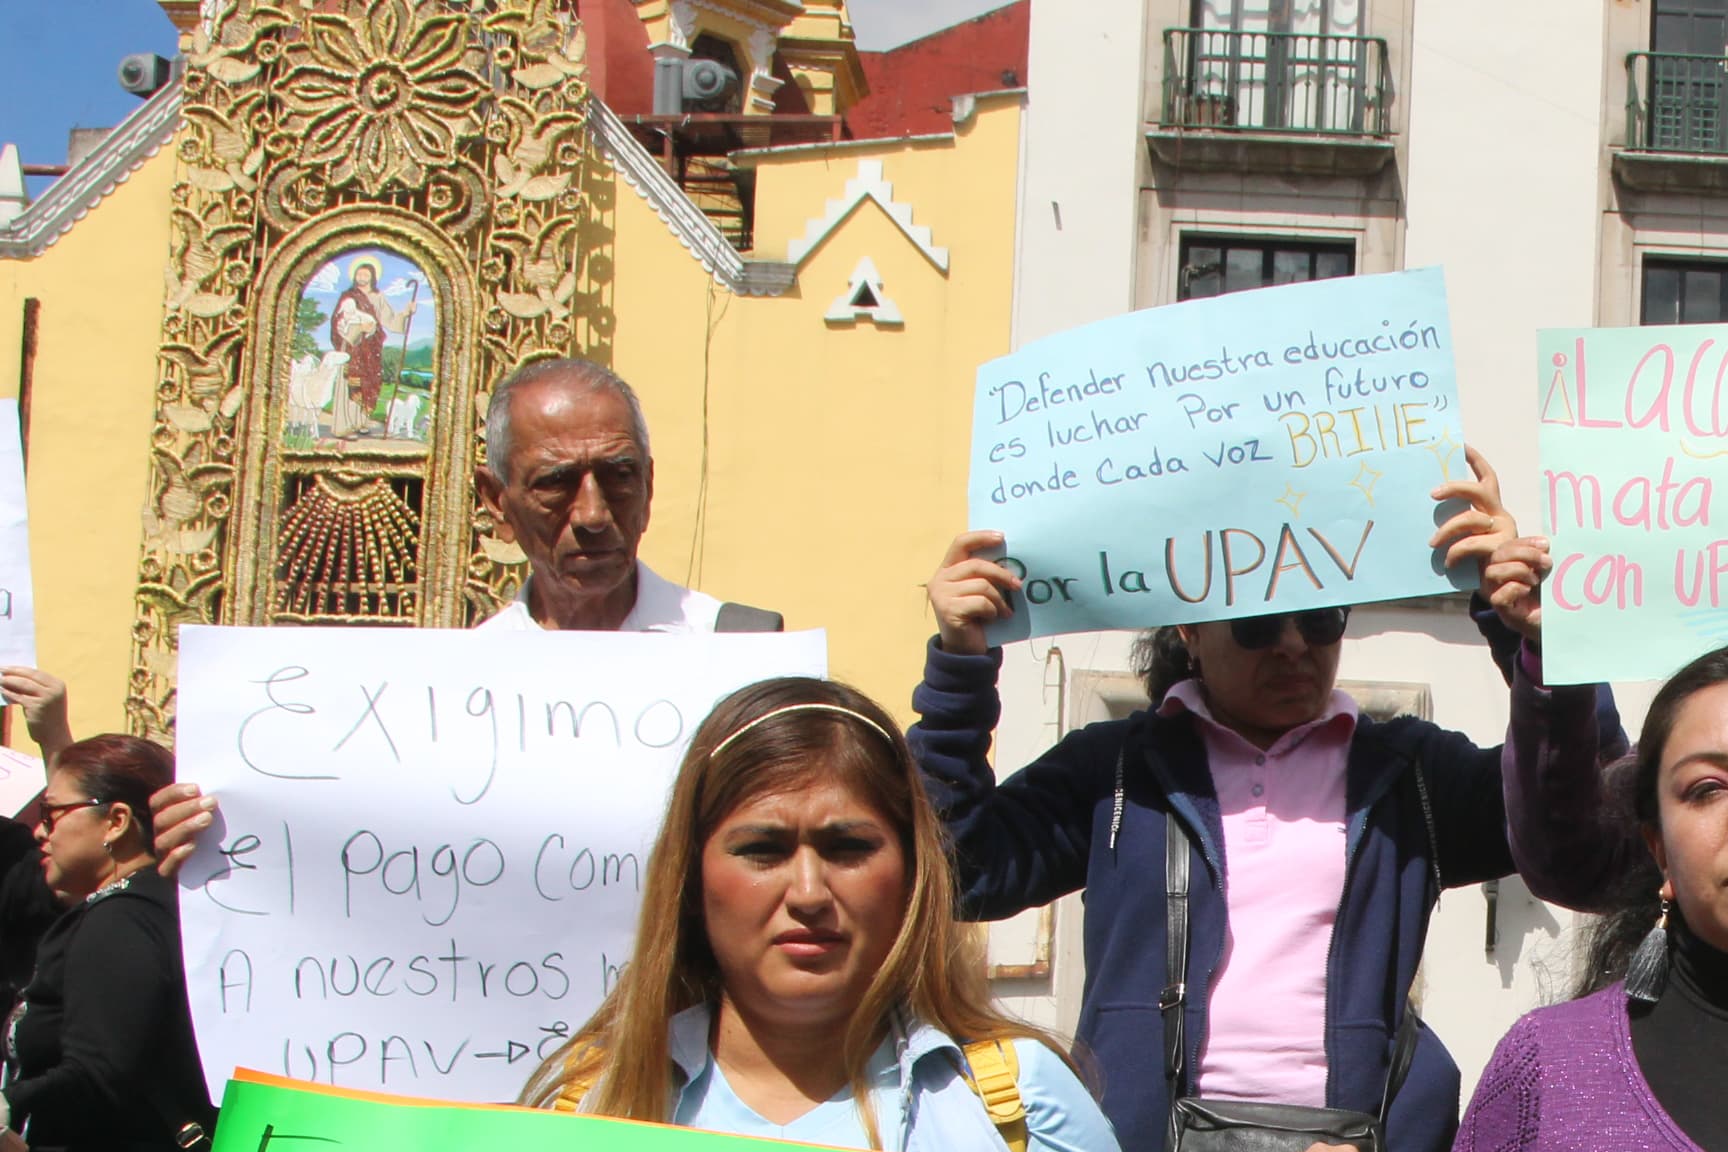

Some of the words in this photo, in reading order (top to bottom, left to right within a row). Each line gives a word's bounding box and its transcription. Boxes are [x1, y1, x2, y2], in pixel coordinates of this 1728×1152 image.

[1284, 320, 1441, 366] educación
[989, 435, 1027, 464] es
[1048, 410, 1149, 449] luchar
[1265, 391, 1307, 413] un
[1325, 368, 1430, 407] futuro
[991, 468, 1081, 504] donde
[1543, 455, 1713, 536] mata
[1098, 550, 1152, 597] la
[1165, 519, 1375, 606] UPAV
[1551, 552, 1643, 611] con
[237, 665, 685, 806] Exigimo
[534, 833, 642, 902] Com
[218, 948, 253, 1014] A
[295, 937, 573, 1003] nuestros
[283, 1030, 471, 1086] UPAV
